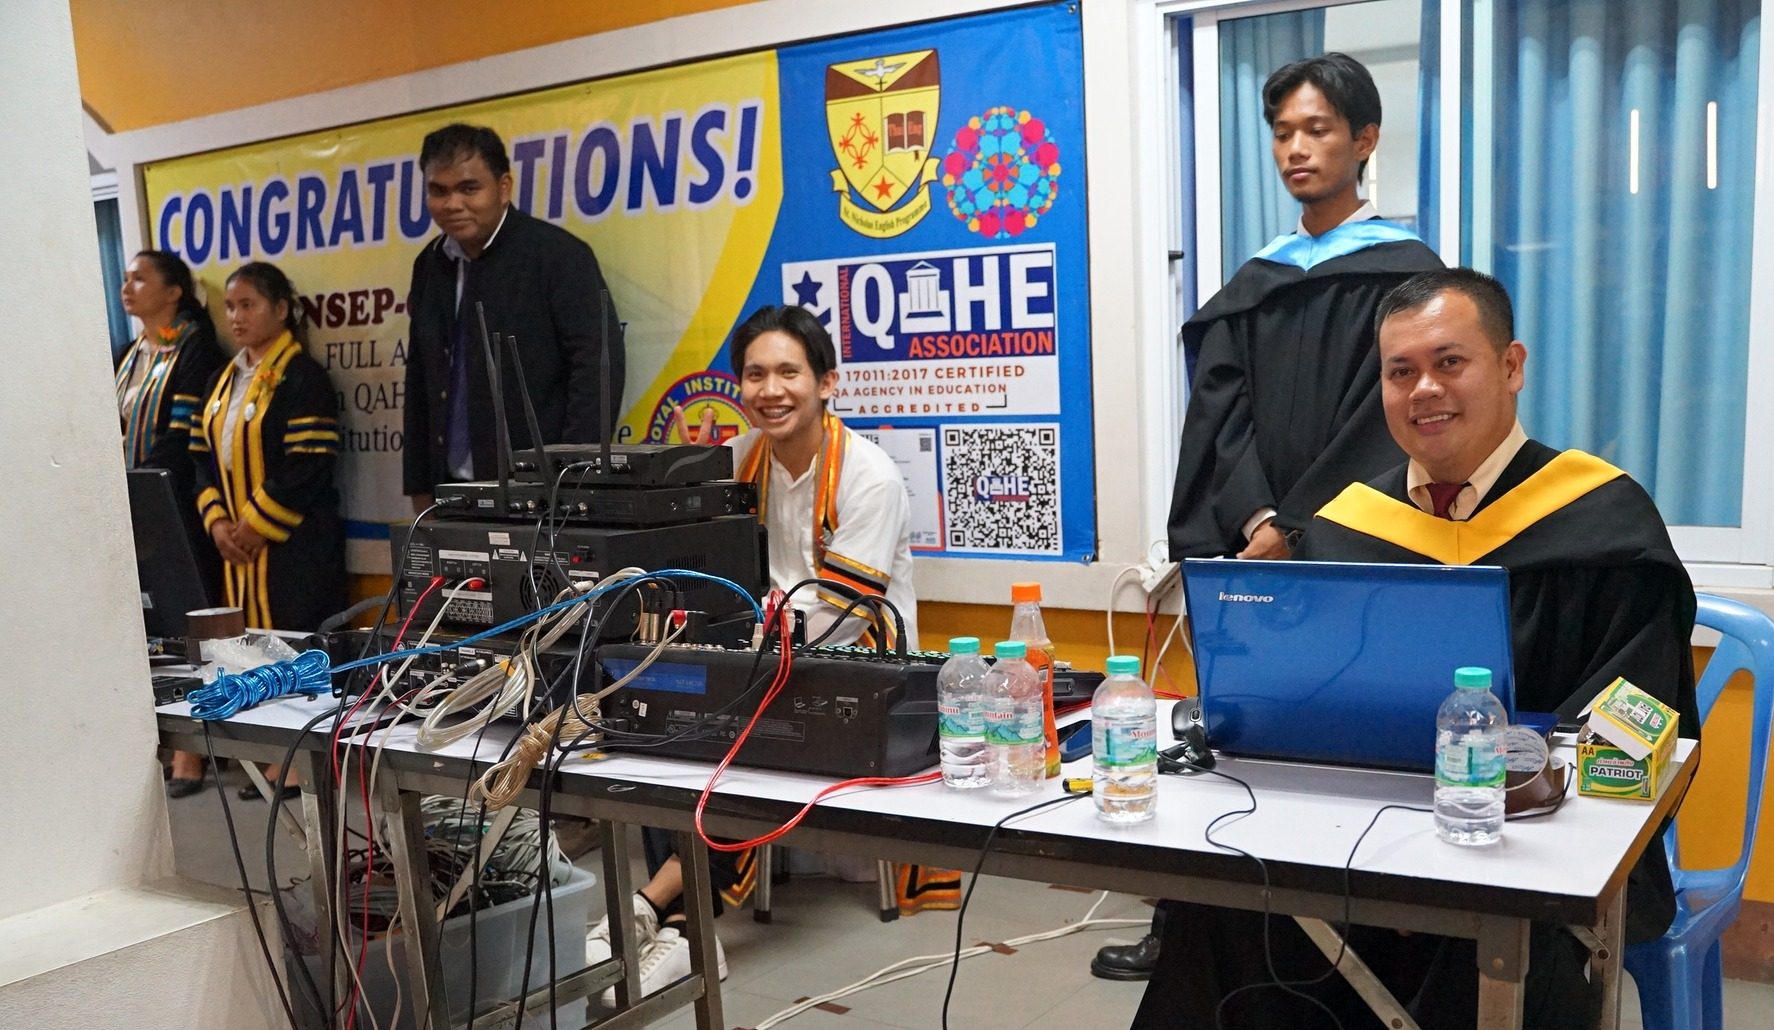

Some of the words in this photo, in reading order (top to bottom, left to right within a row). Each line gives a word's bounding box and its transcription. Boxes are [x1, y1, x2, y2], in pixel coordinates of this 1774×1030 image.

[159, 106, 757, 265] CONGRATUTIONS!
[839, 267, 853, 358] INTERNATIONAL
[326, 340, 382, 370] FULL
[390, 338, 409, 367] A
[909, 332, 1053, 359] ASSOCIATION
[846, 369, 928, 383] 17011:2017
[935, 365, 1025, 380] CERTIFIED
[684, 376, 741, 399] INSTIT
[854, 386, 904, 398] AGENCY
[909, 385, 922, 396] IN
[928, 383, 1007, 396] EDUCATION
[858, 403, 980, 415] ACCREDITED
[651, 396, 679, 444] OYAL
[1219, 591, 1274, 603] lenovo
[1581, 745, 1595, 756] AA
[1590, 766, 1642, 779] PATRIOT
